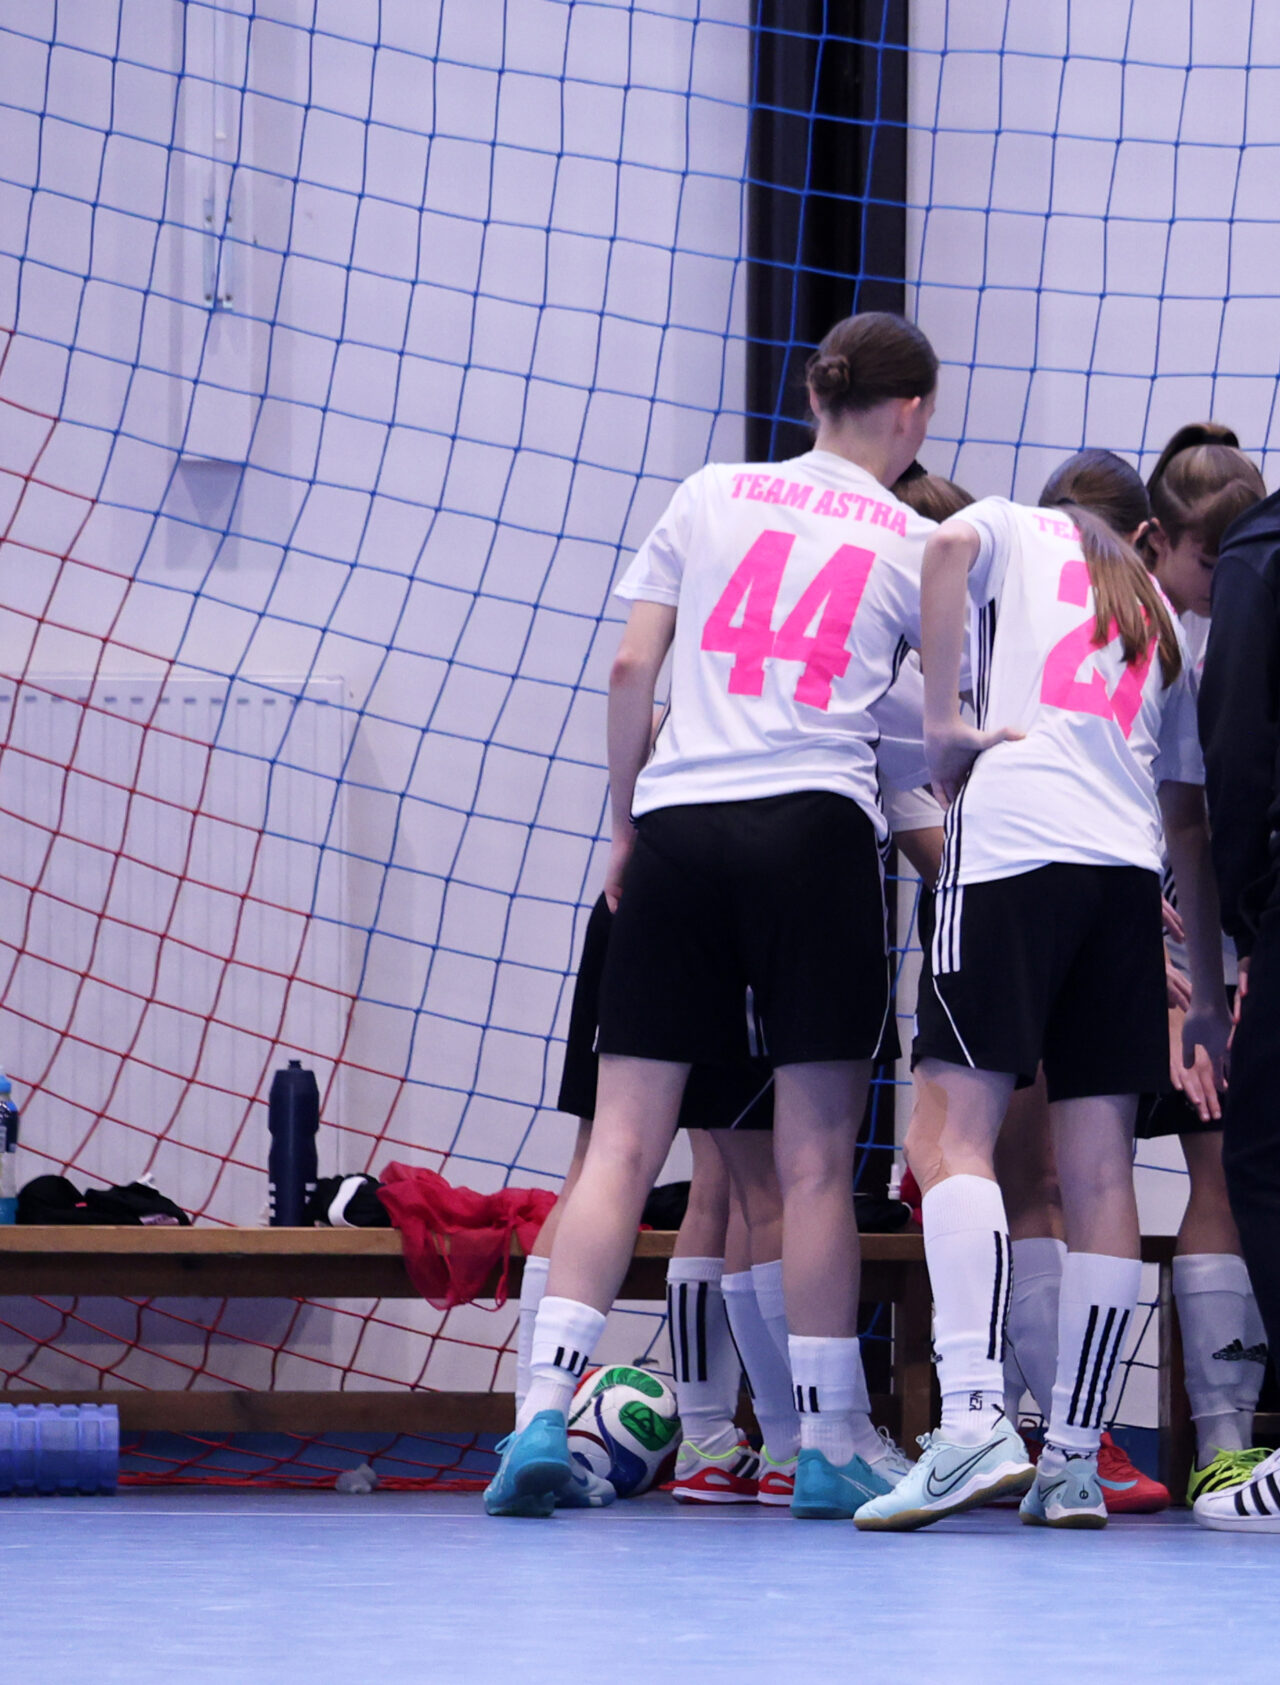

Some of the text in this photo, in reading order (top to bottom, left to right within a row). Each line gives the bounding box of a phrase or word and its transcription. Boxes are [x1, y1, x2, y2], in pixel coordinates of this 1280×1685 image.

[731, 472, 907, 538] TEAM ASTRA
[701, 529, 876, 711] 44
